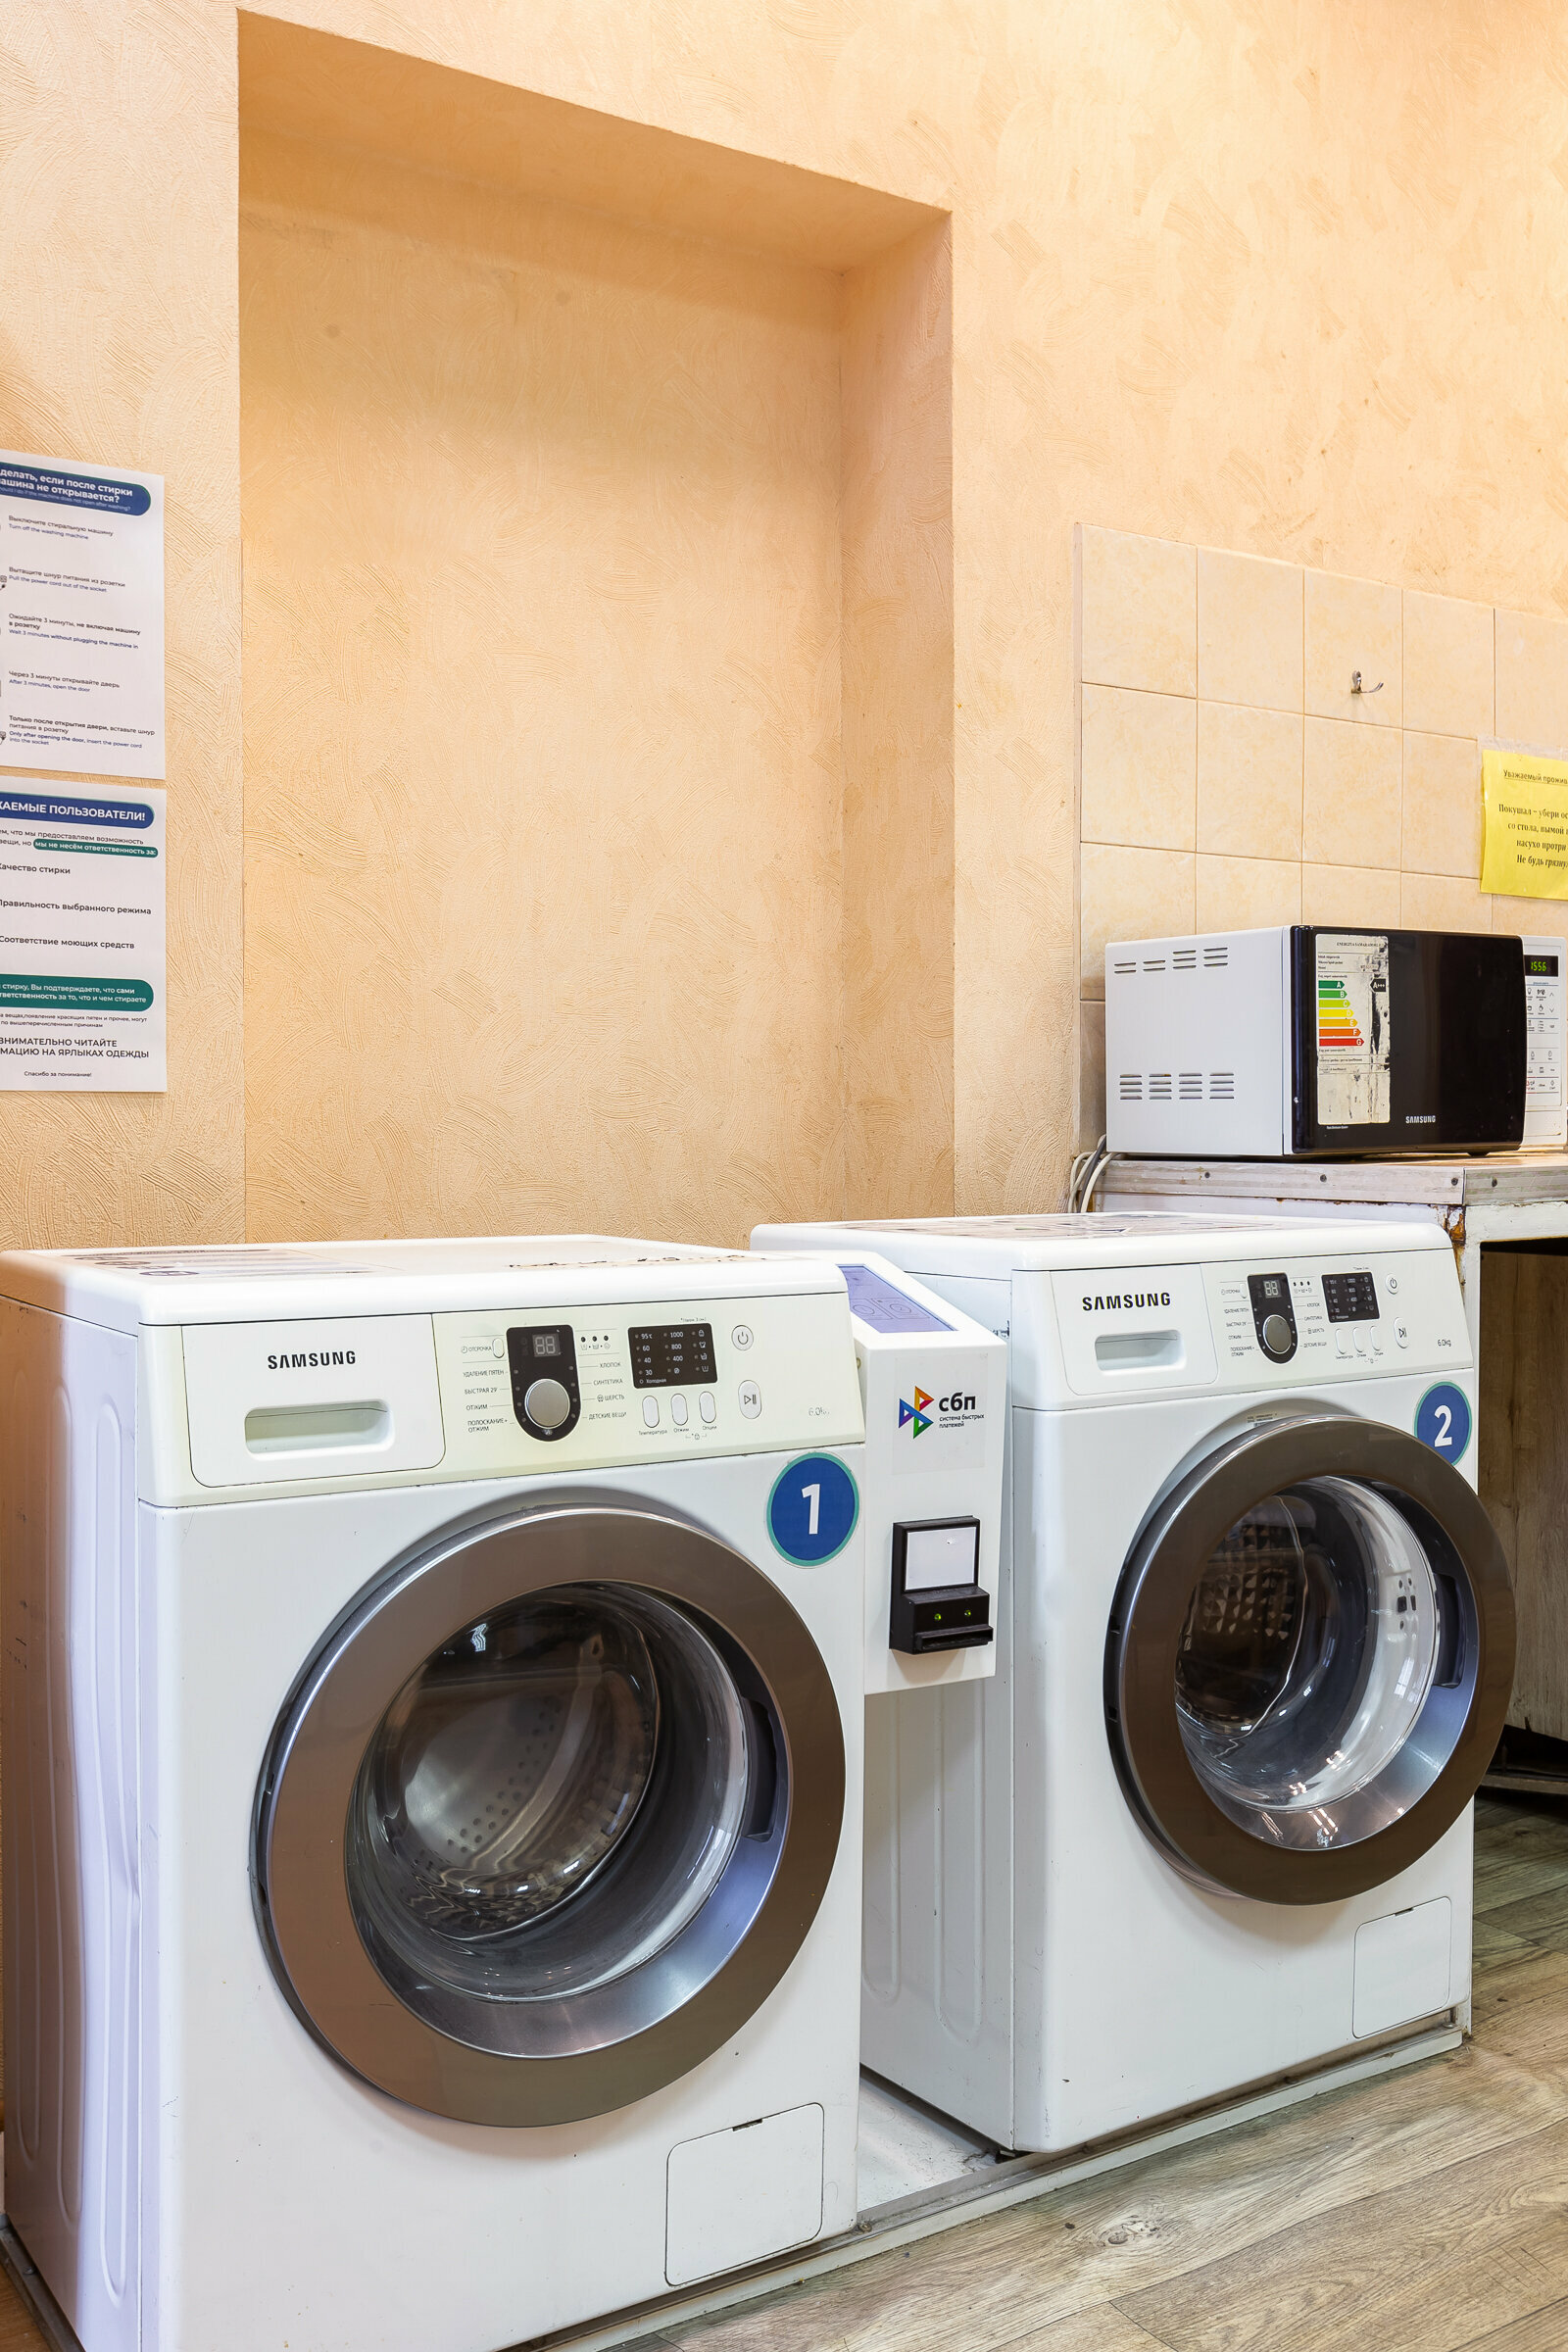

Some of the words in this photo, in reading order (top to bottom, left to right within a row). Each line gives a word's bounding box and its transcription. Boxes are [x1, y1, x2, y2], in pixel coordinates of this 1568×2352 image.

[0, 469, 38, 481] делать,
[40, 476, 64, 485] если
[67, 480, 96, 490] после
[98, 486, 132, 497] стирки
[0, 479, 34, 489] ашина
[51, 487, 120, 503] открывается?
[9, 515, 46, 525] Выключите
[48, 522, 86, 532] стиральную
[9, 567, 42, 575] Вытащите
[9, 613, 42, 622] Ожидайте
[1504, 769, 1542, 781] Уважаемый
[50, 805, 145, 821] ПОЛЬЗОВАТЕЛИ!
[1499, 804, 1531, 815] Покушал
[1539, 809, 1559, 819] убери
[1517, 823, 1538, 833] стола,
[1540, 826, 1564, 835] вымой
[38, 832, 94, 841] предоставляем
[96, 837, 143, 845] возможность
[84, 846, 145, 854] ответственность
[1517, 840, 1540, 850] насухо
[1542, 842, 1566, 853] протри
[1517, 854, 1526, 863] Не
[1528, 856, 1544, 866] будь
[1545, 858, 1568, 869] грязну
[63, 903, 115, 912] выбранного
[0, 936, 58, 945] Соответствие
[74, 1039, 117, 1047] ЧИТАЙТЕ
[106, 1050, 148, 1058] ОДЕЖДЫ
[1406, 1115, 1436, 1124] SAMSUNG
[1082, 1293, 1171, 1311] SAMSUNG
[268, 1351, 356, 1369] SAMSUNG
[939, 1392, 976, 1412] сбп
[1434, 1405, 1452, 1447] 2
[801, 1484, 820, 1535] 1
